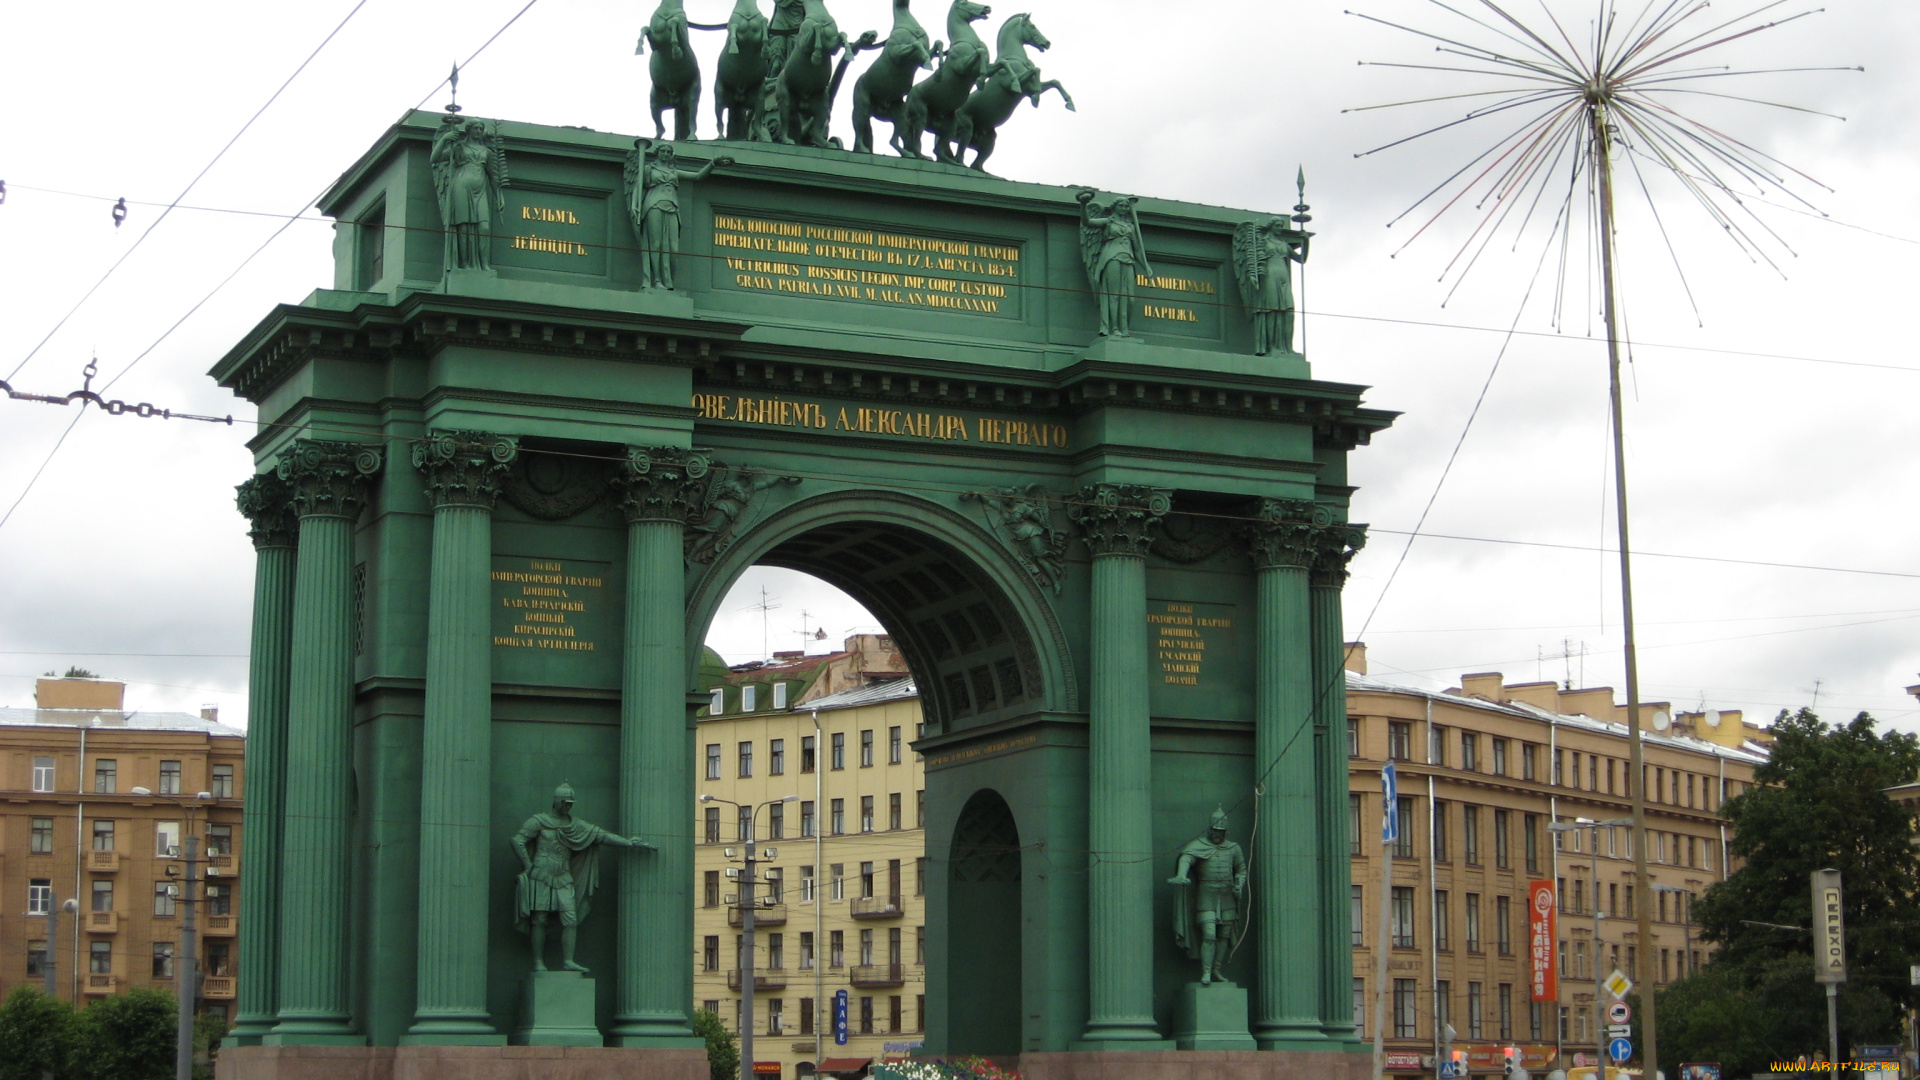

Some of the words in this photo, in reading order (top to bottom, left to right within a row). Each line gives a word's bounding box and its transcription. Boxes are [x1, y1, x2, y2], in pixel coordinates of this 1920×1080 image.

[522, 206, 580, 225] КУЛЬМЪ.
[714, 232, 811, 256] ПРИЗНАТЕЛЬНОЕ
[815, 244, 883, 263] ОТЕЧЕСТВО
[887, 251, 903, 265] ВЪ
[907, 253, 921, 267] 17
[937, 258, 985, 274] АВГУСТА
[877, 233, 969, 256] ИМПЕРАТОРСКОЙ
[726, 257, 800, 277] VICTRICIBUS
[808, 265, 858, 283] ROSSICIS
[904, 275, 926, 290] IMP.
[928, 278, 957, 293] CORP.
[960, 281, 1008, 298] CUSTOD.
[736, 274, 773, 290] GRATA
[1144, 304, 1198, 322] ПАРИЖЪ.
[834, 406, 969, 441] АЛЕКСАНДРА
[1826, 892, 1843, 968] ПЕРЕХОД
[1533, 922, 1545, 996] ЧАЙНАЯ
[838, 997, 847, 1042] КАФЕ
